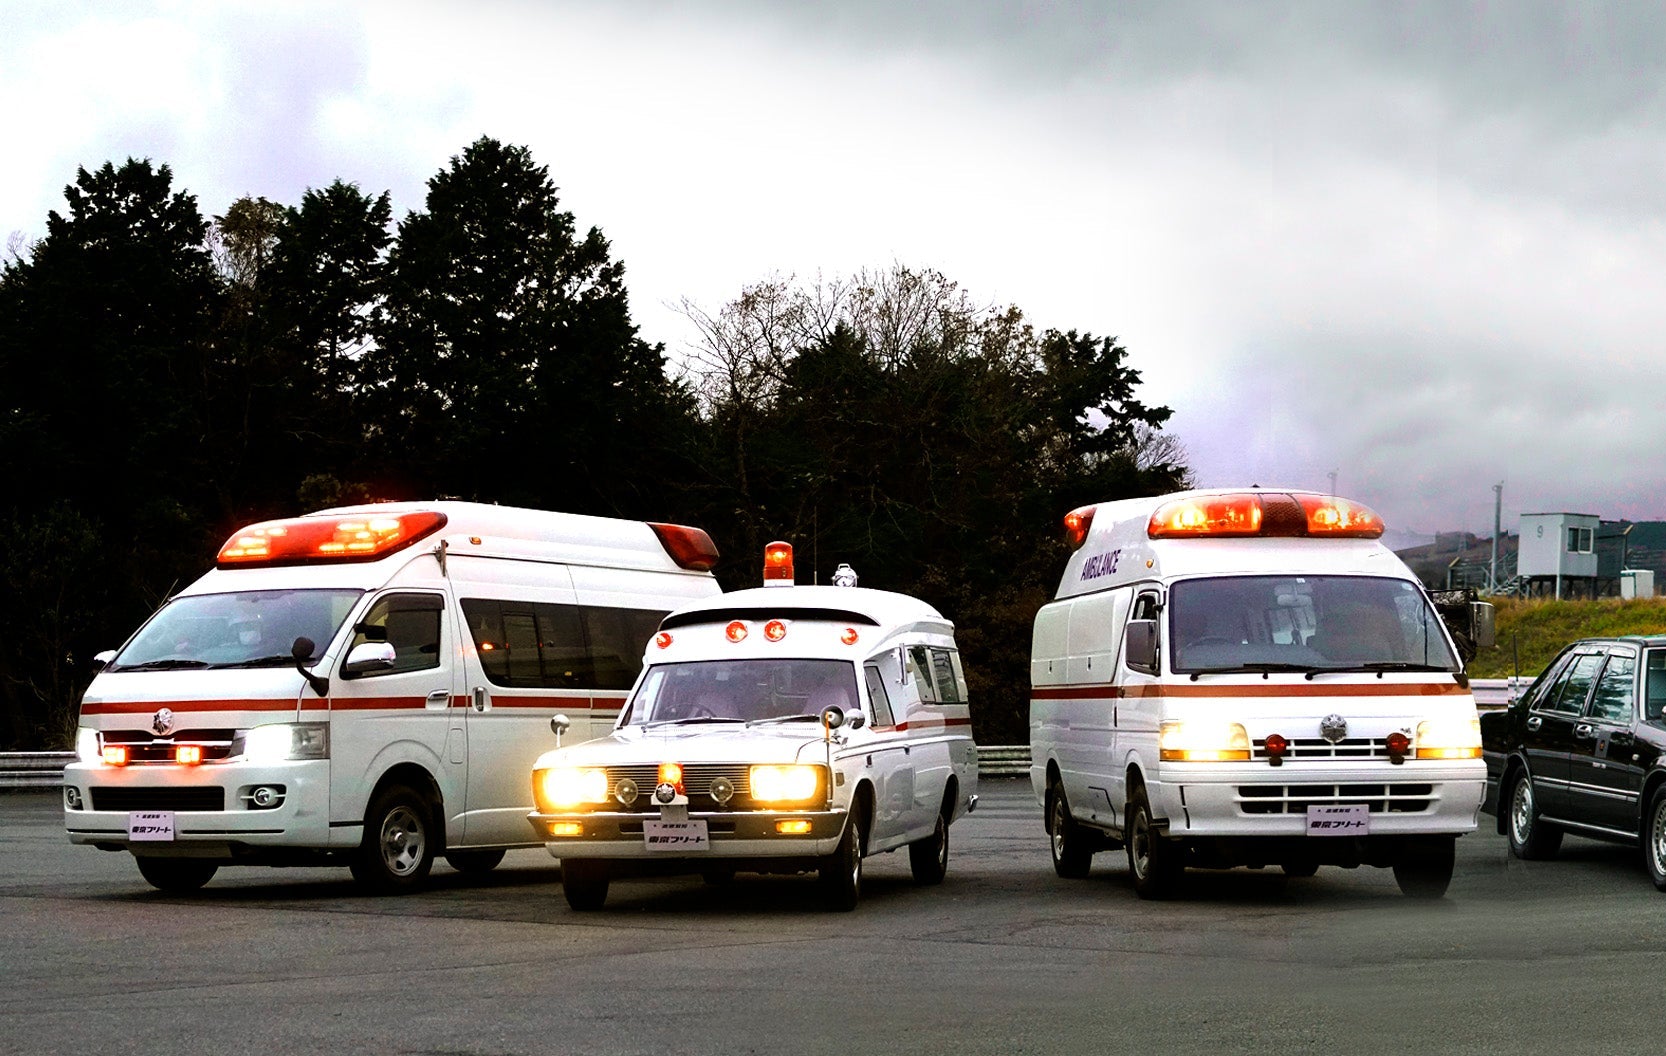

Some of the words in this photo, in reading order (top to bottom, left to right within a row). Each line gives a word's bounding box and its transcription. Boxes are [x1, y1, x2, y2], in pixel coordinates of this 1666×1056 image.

[1537, 525, 1543, 538] 9
[1080, 549, 1121, 581] AMBULANCE
[1311, 821, 1366, 829] 東京フリート
[649, 835, 705, 843] 東京フリート
